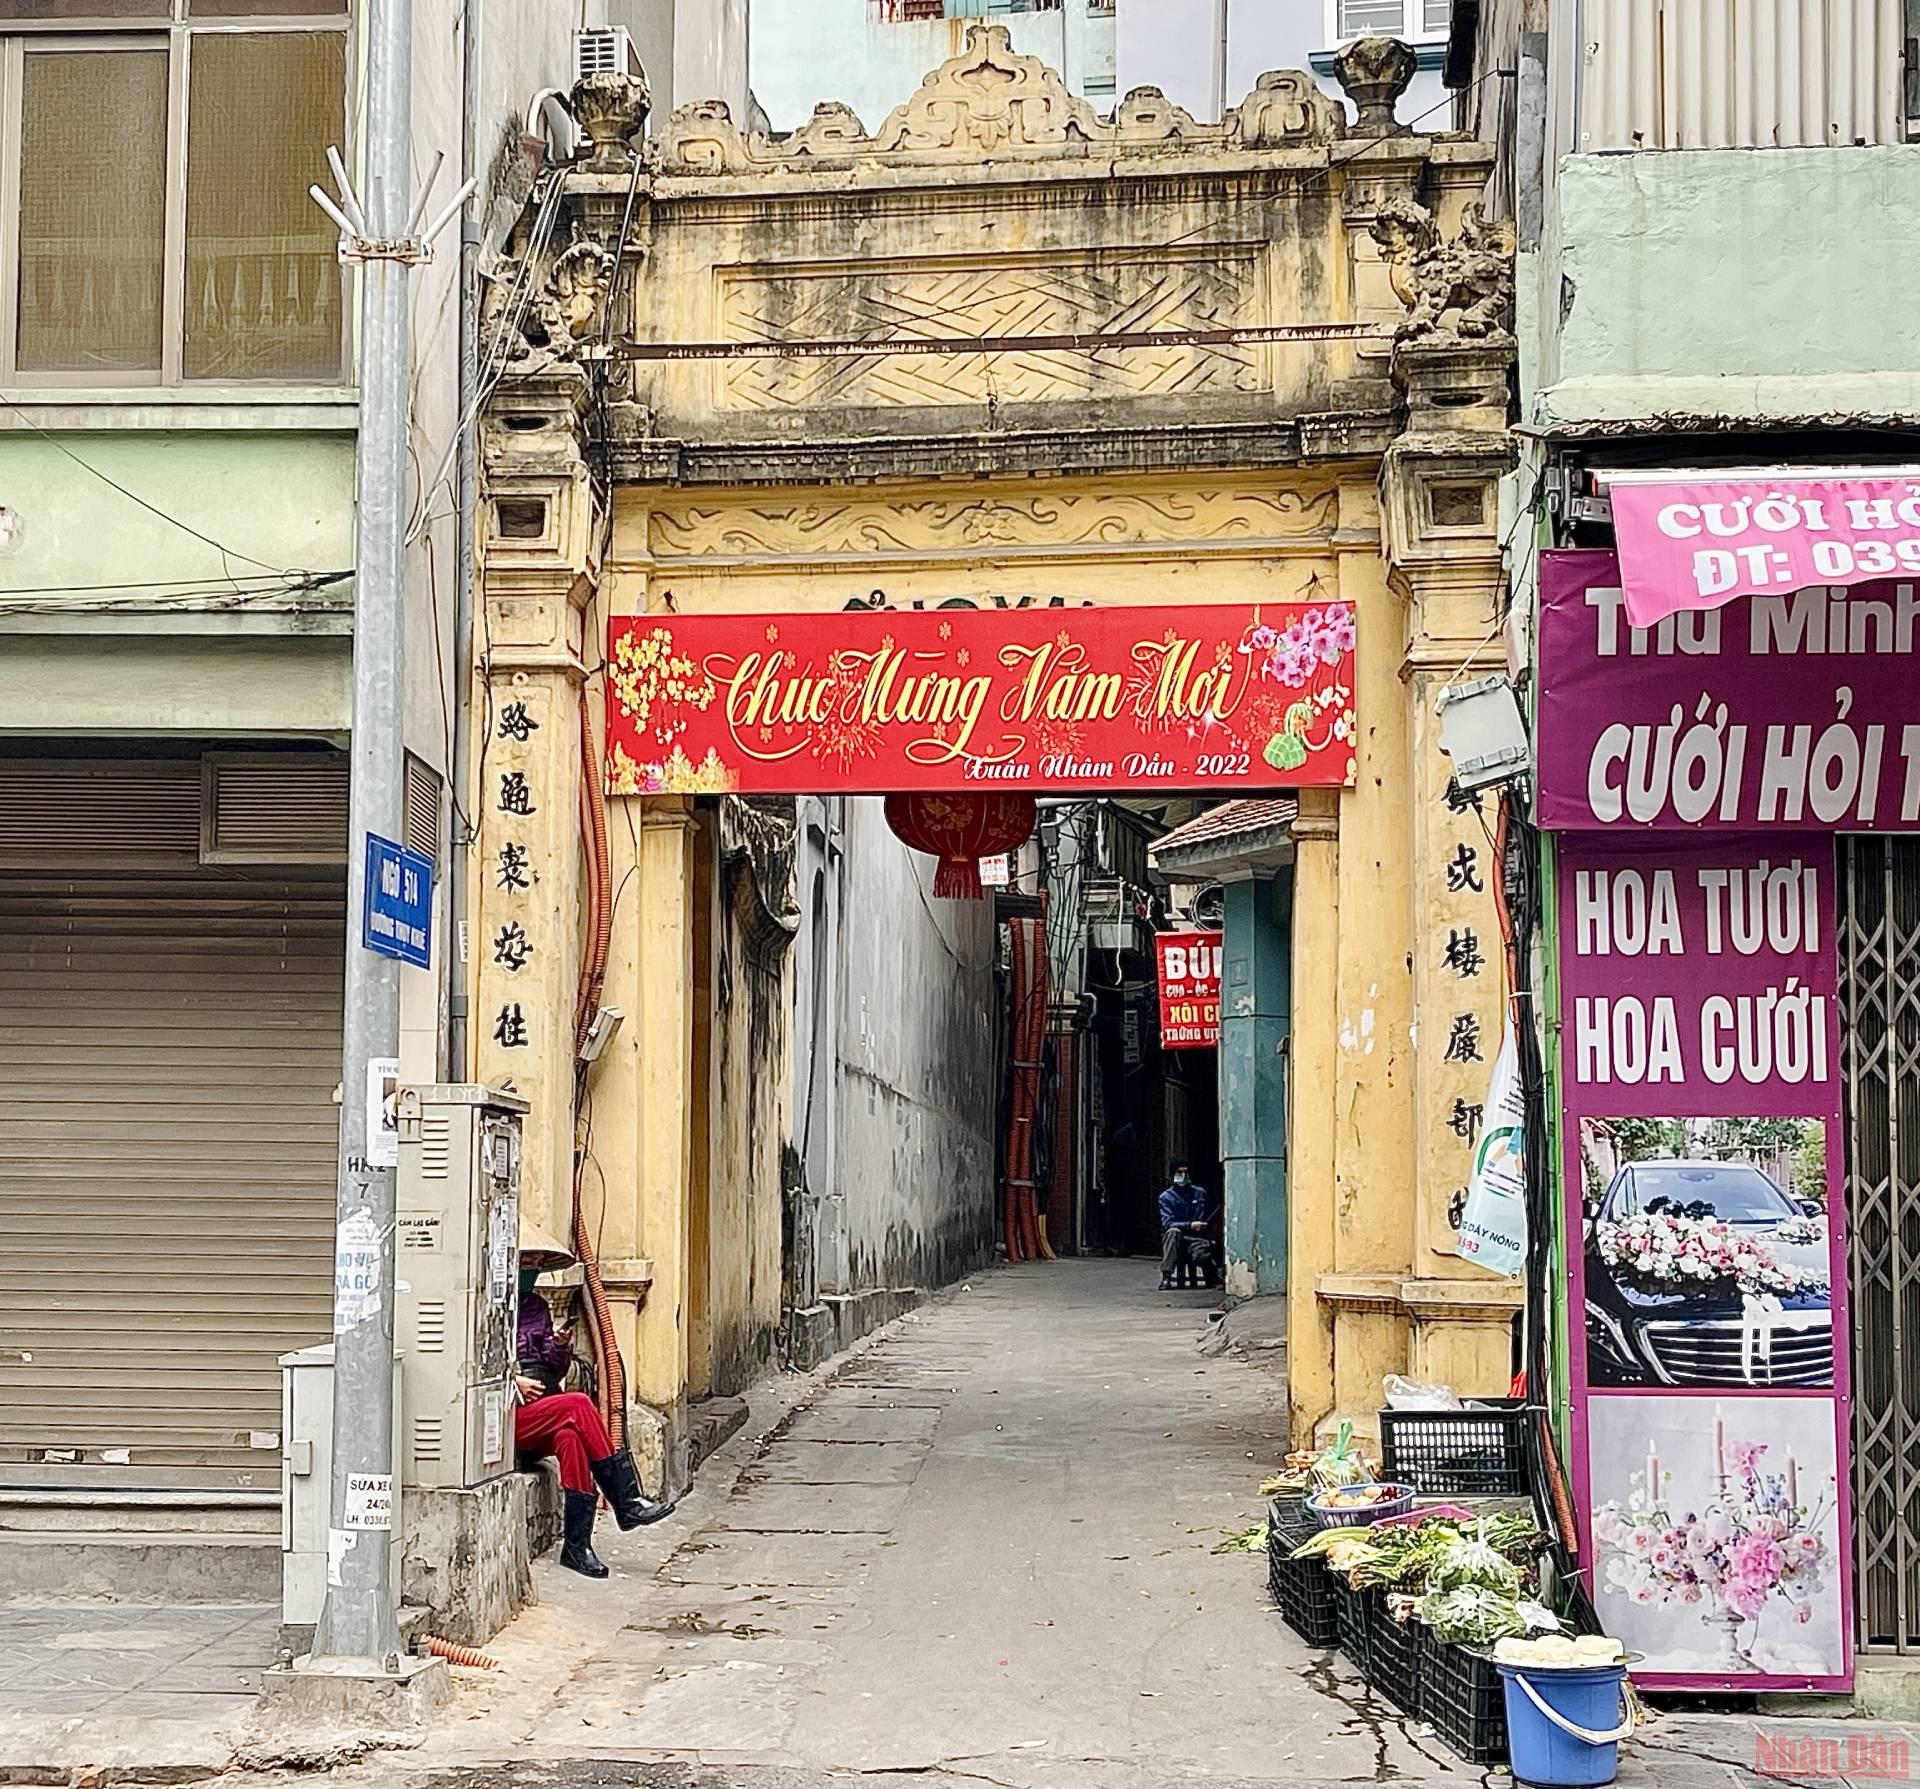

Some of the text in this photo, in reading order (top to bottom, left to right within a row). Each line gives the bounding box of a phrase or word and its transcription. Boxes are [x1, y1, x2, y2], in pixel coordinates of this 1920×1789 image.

[1657, 491, 1830, 539] CƯỚI
[1692, 544, 1793, 598] ĐT:
[702, 650, 838, 760] Chúc
[999, 641, 1125, 722] Năm
[1131, 639, 1251, 719] Mới
[965, 755, 1030, 780] Xuân
[1039, 753, 1114, 779] Nhâm
[1122, 751, 1175, 777] Dần
[1198, 753, 1250, 777] 2022
[1588, 691, 1748, 823] CƯỚI
[1757, 685, 1886, 822] HỎI
[1575, 859, 1819, 956] HOA TƯƠI
[1170, 1002, 1198, 1024] XÔI
[1575, 976, 1828, 1084] HOA CƯỚI
[358, 1183, 369, 1199] 7
